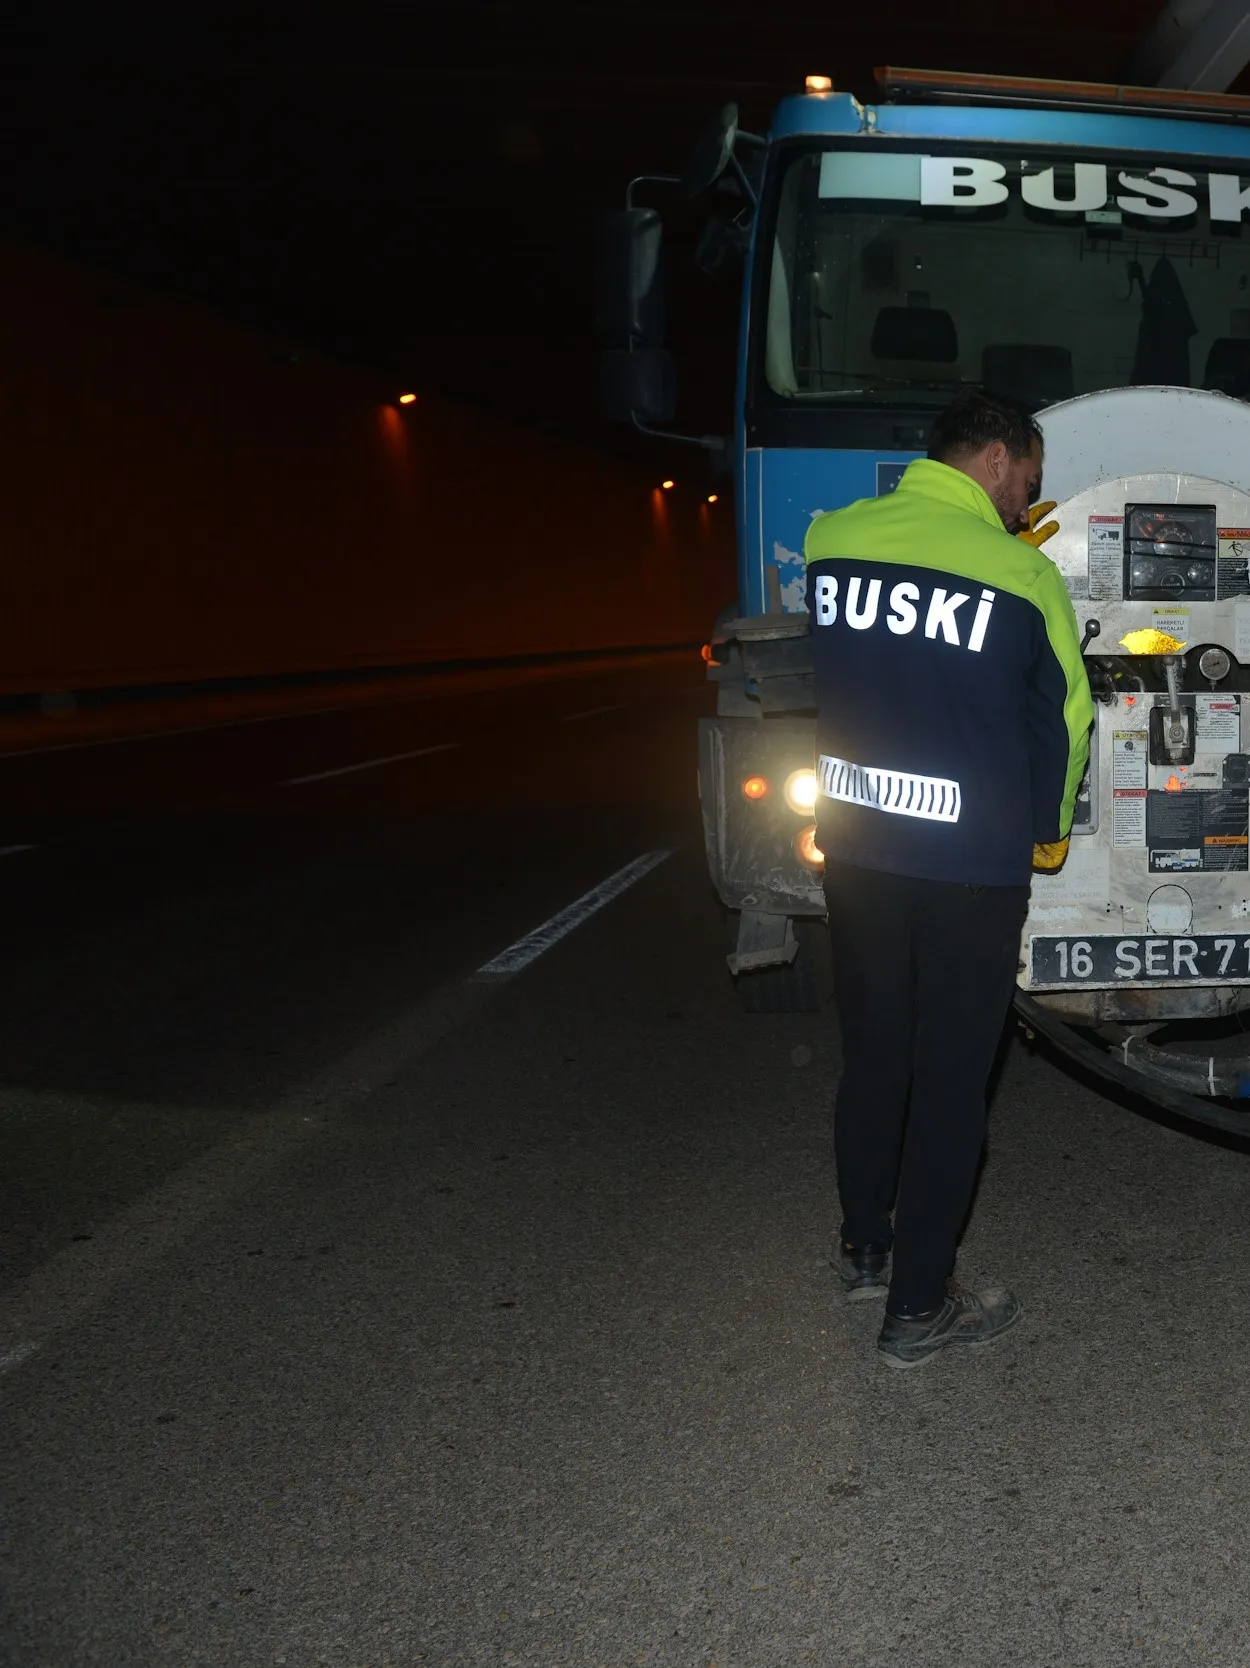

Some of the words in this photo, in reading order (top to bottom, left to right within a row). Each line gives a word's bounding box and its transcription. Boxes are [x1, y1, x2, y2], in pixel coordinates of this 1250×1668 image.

[815, 574, 996, 653] BUSKİ
[1055, 940, 1094, 979] 16
[1114, 937, 1200, 979] SER
